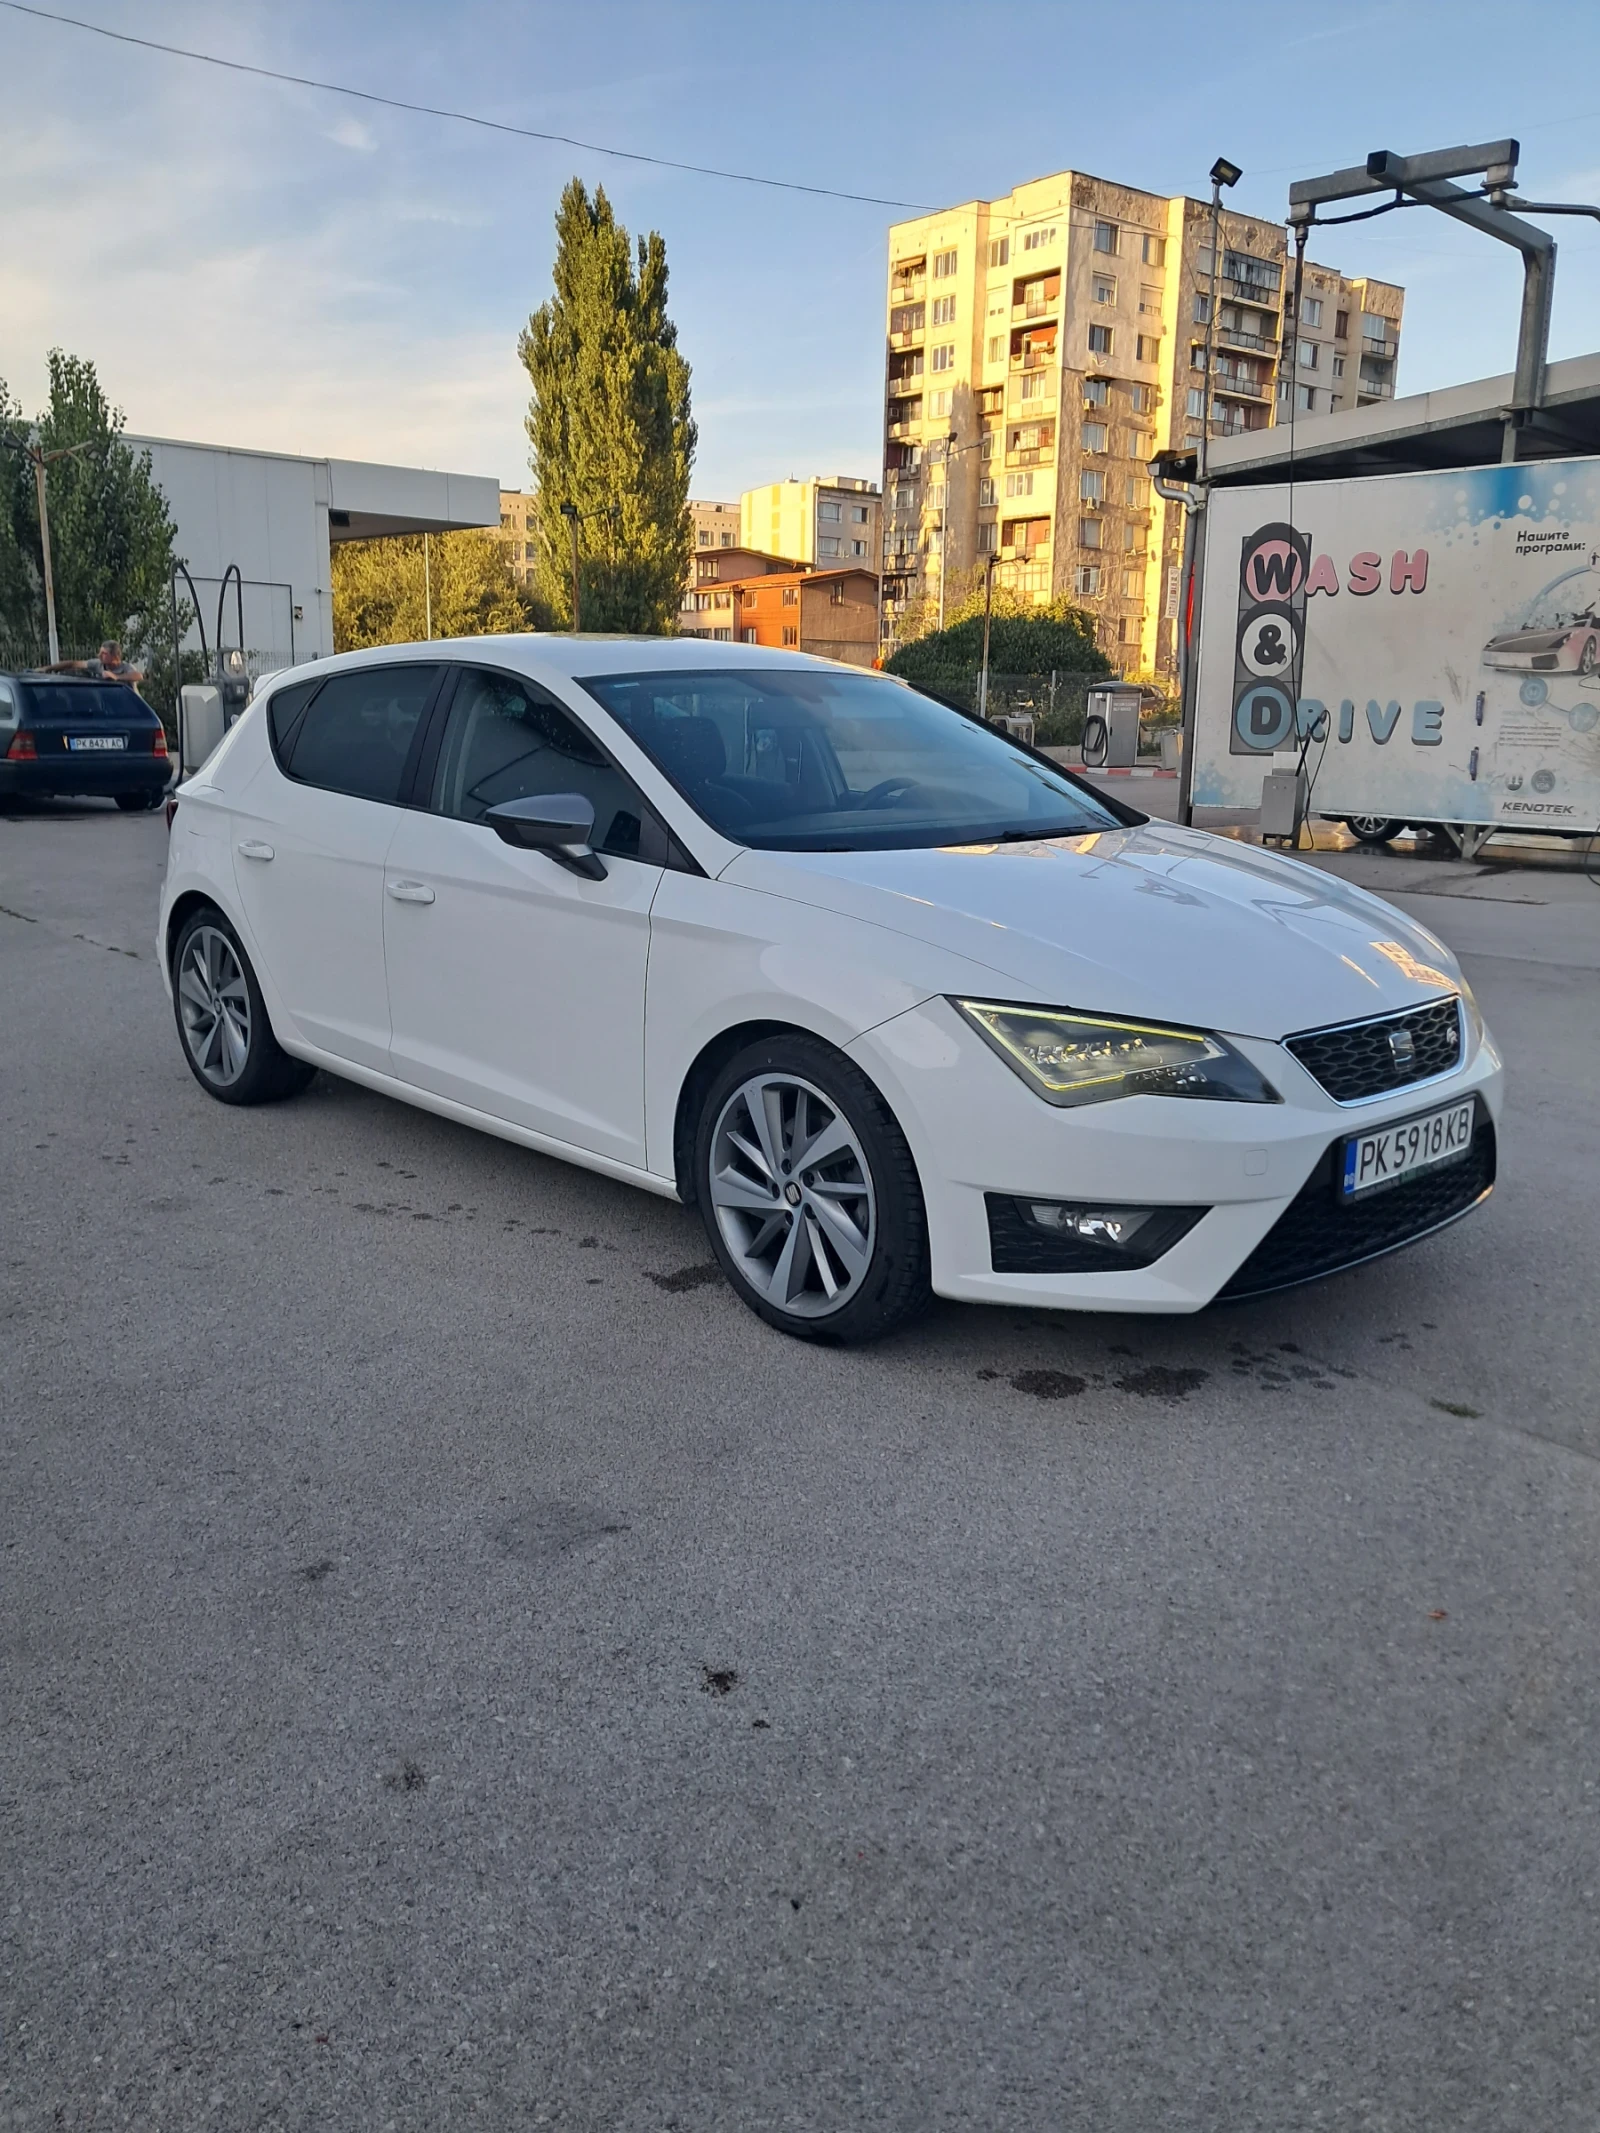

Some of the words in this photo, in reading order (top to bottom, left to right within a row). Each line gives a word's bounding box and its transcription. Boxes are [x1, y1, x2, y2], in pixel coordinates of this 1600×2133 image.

[1515, 542, 1586, 556] програми:
[1517, 530, 1570, 542] Нашите
[1253, 549, 1429, 597] WASH
[1254, 624, 1288, 665] &
[1250, 698, 1445, 746] DRIVE
[1502, 801, 1574, 814] KENOTEK
